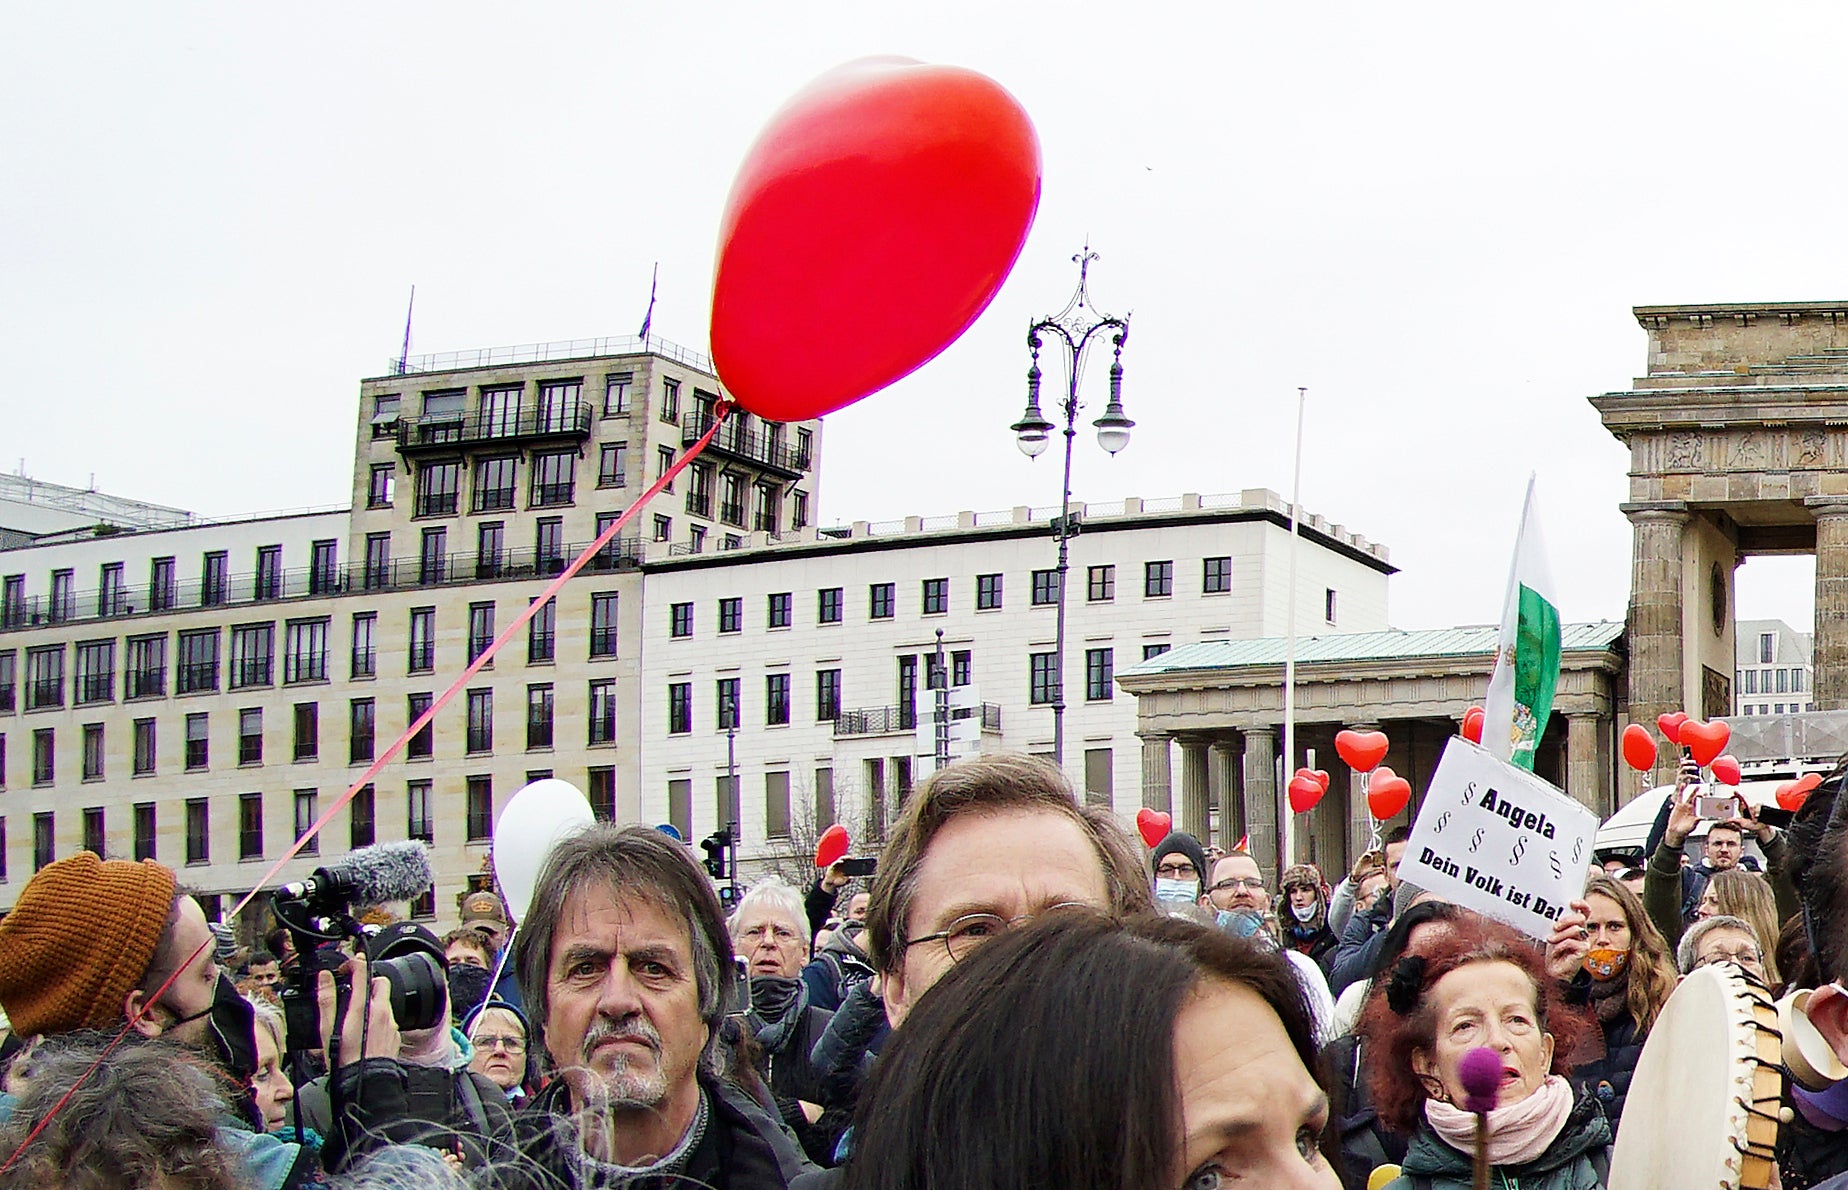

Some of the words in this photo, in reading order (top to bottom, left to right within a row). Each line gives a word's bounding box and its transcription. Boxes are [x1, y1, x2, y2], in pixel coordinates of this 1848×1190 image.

[1479, 788, 1556, 840] Angela
[1419, 846, 1460, 878] Dein
[1464, 866, 1504, 897] Volk
[1505, 885, 1532, 908] ist
[1532, 897, 1565, 922] Da!
